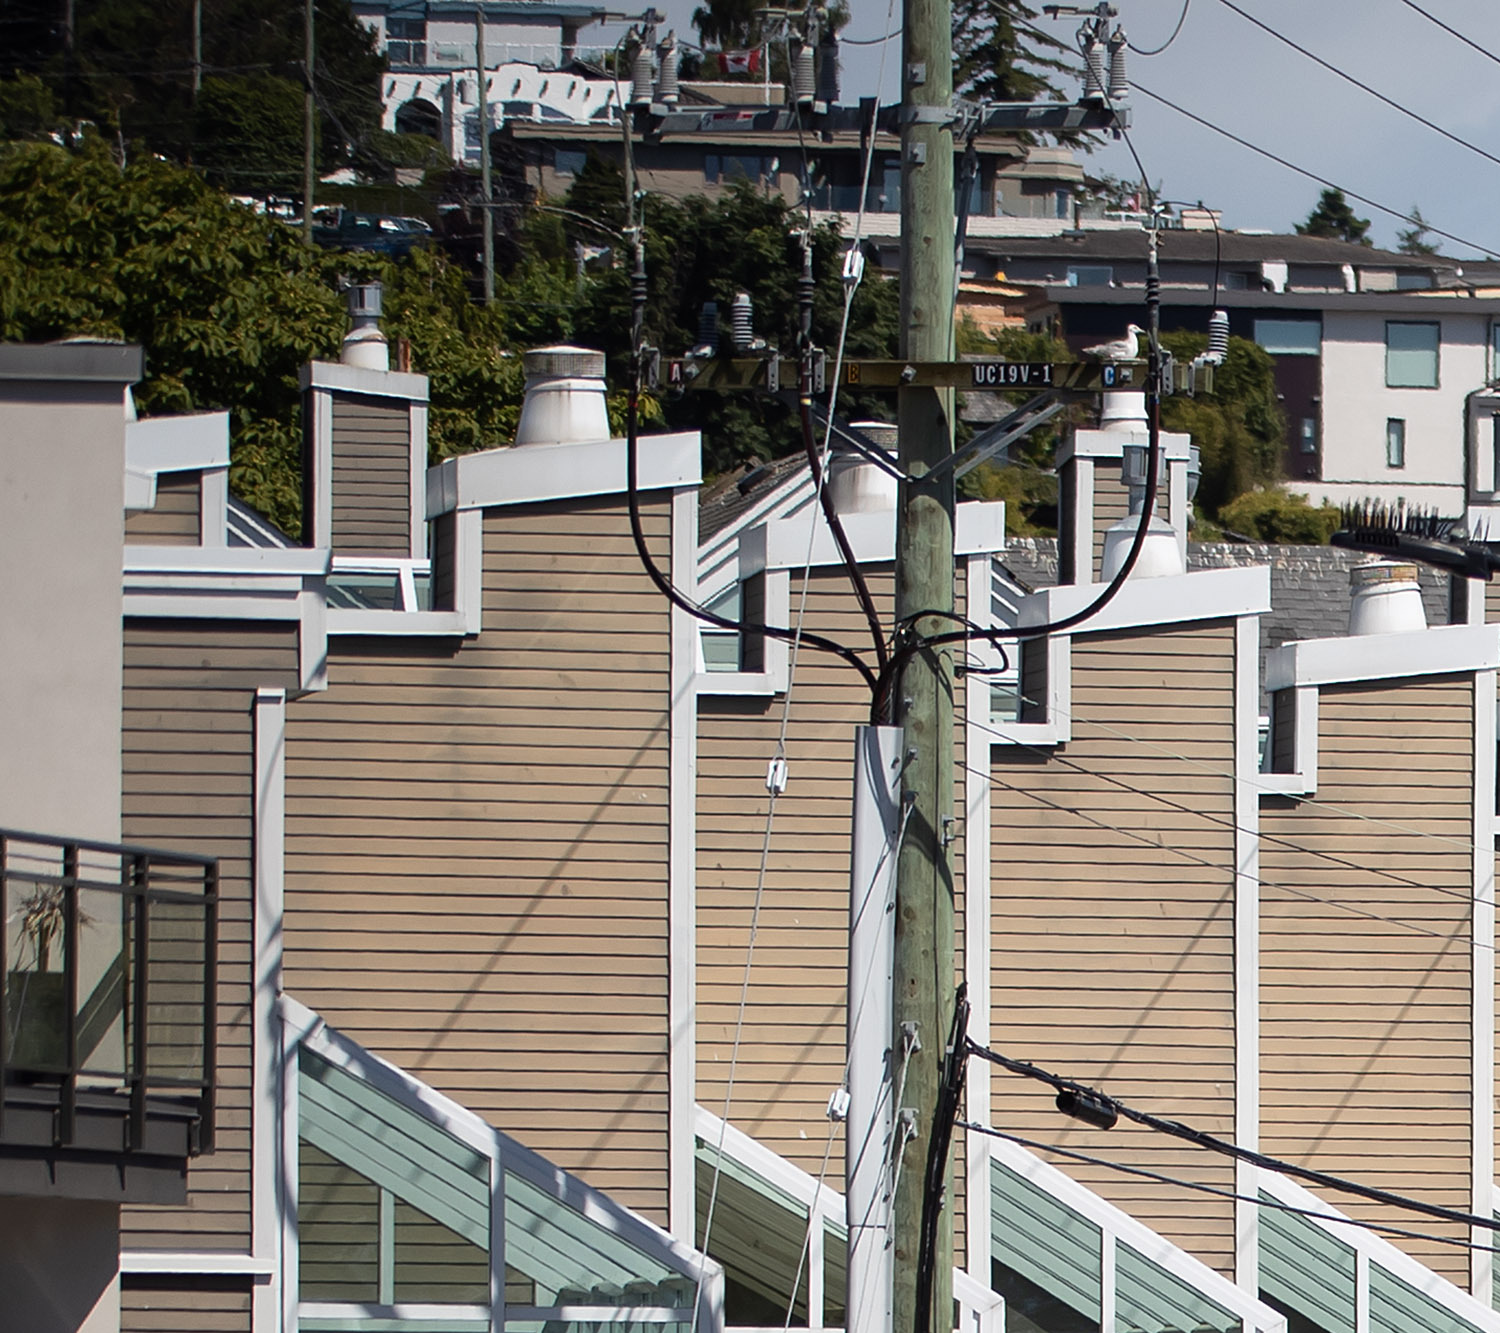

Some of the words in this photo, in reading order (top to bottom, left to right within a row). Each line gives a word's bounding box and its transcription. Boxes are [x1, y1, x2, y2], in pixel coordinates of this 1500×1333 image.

[671, 363, 681, 382] A
[975, 364, 1052, 384] UC19V-1
[1104, 366, 1115, 384] C
